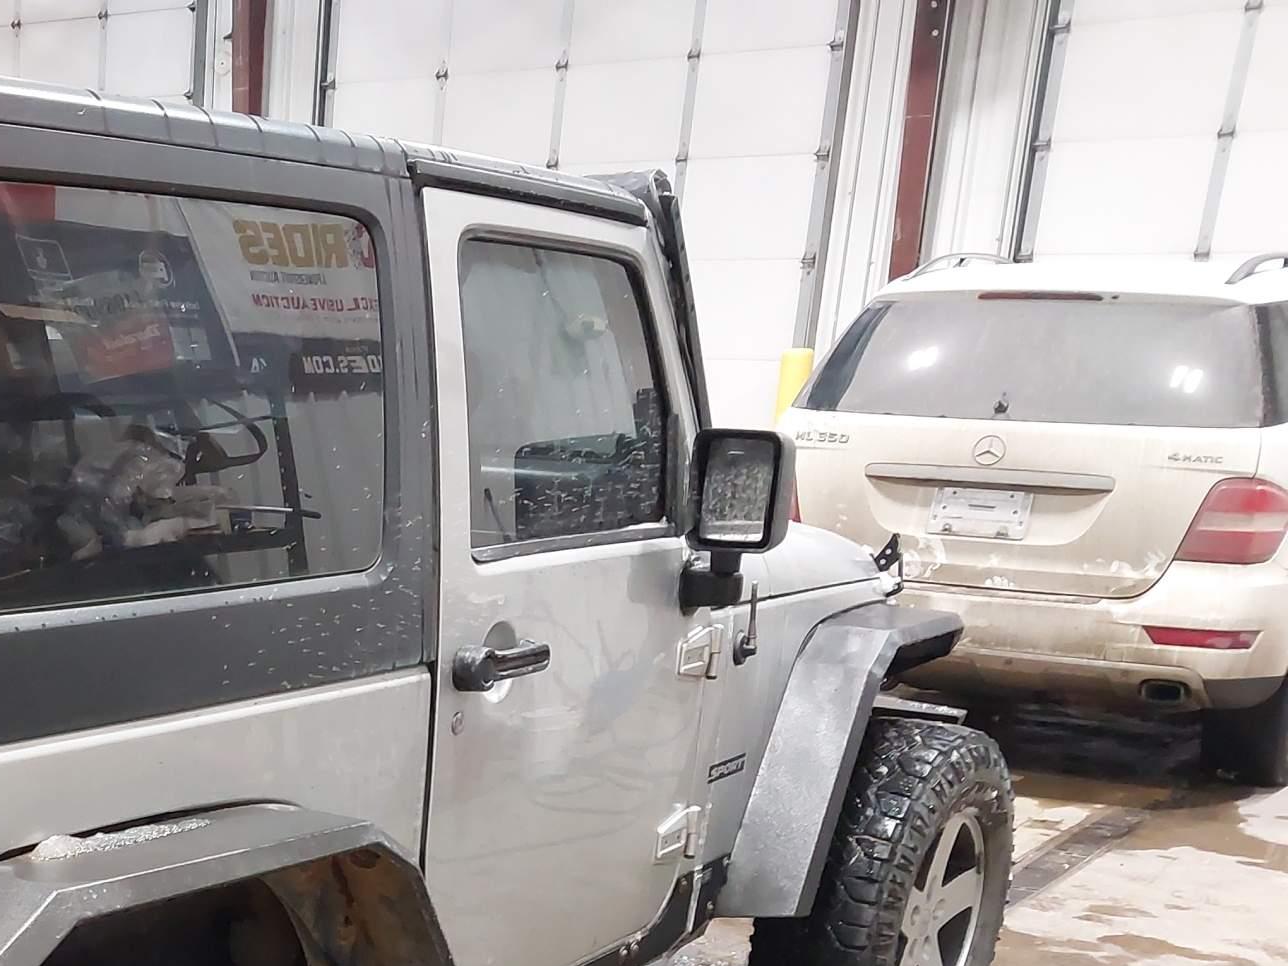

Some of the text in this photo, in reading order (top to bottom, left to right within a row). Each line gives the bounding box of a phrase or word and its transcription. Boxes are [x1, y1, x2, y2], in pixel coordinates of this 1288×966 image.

[796, 431, 850, 443] ML 350
[1167, 452, 1224, 464] 4MATIC
[710, 758, 744, 777] SPORT
